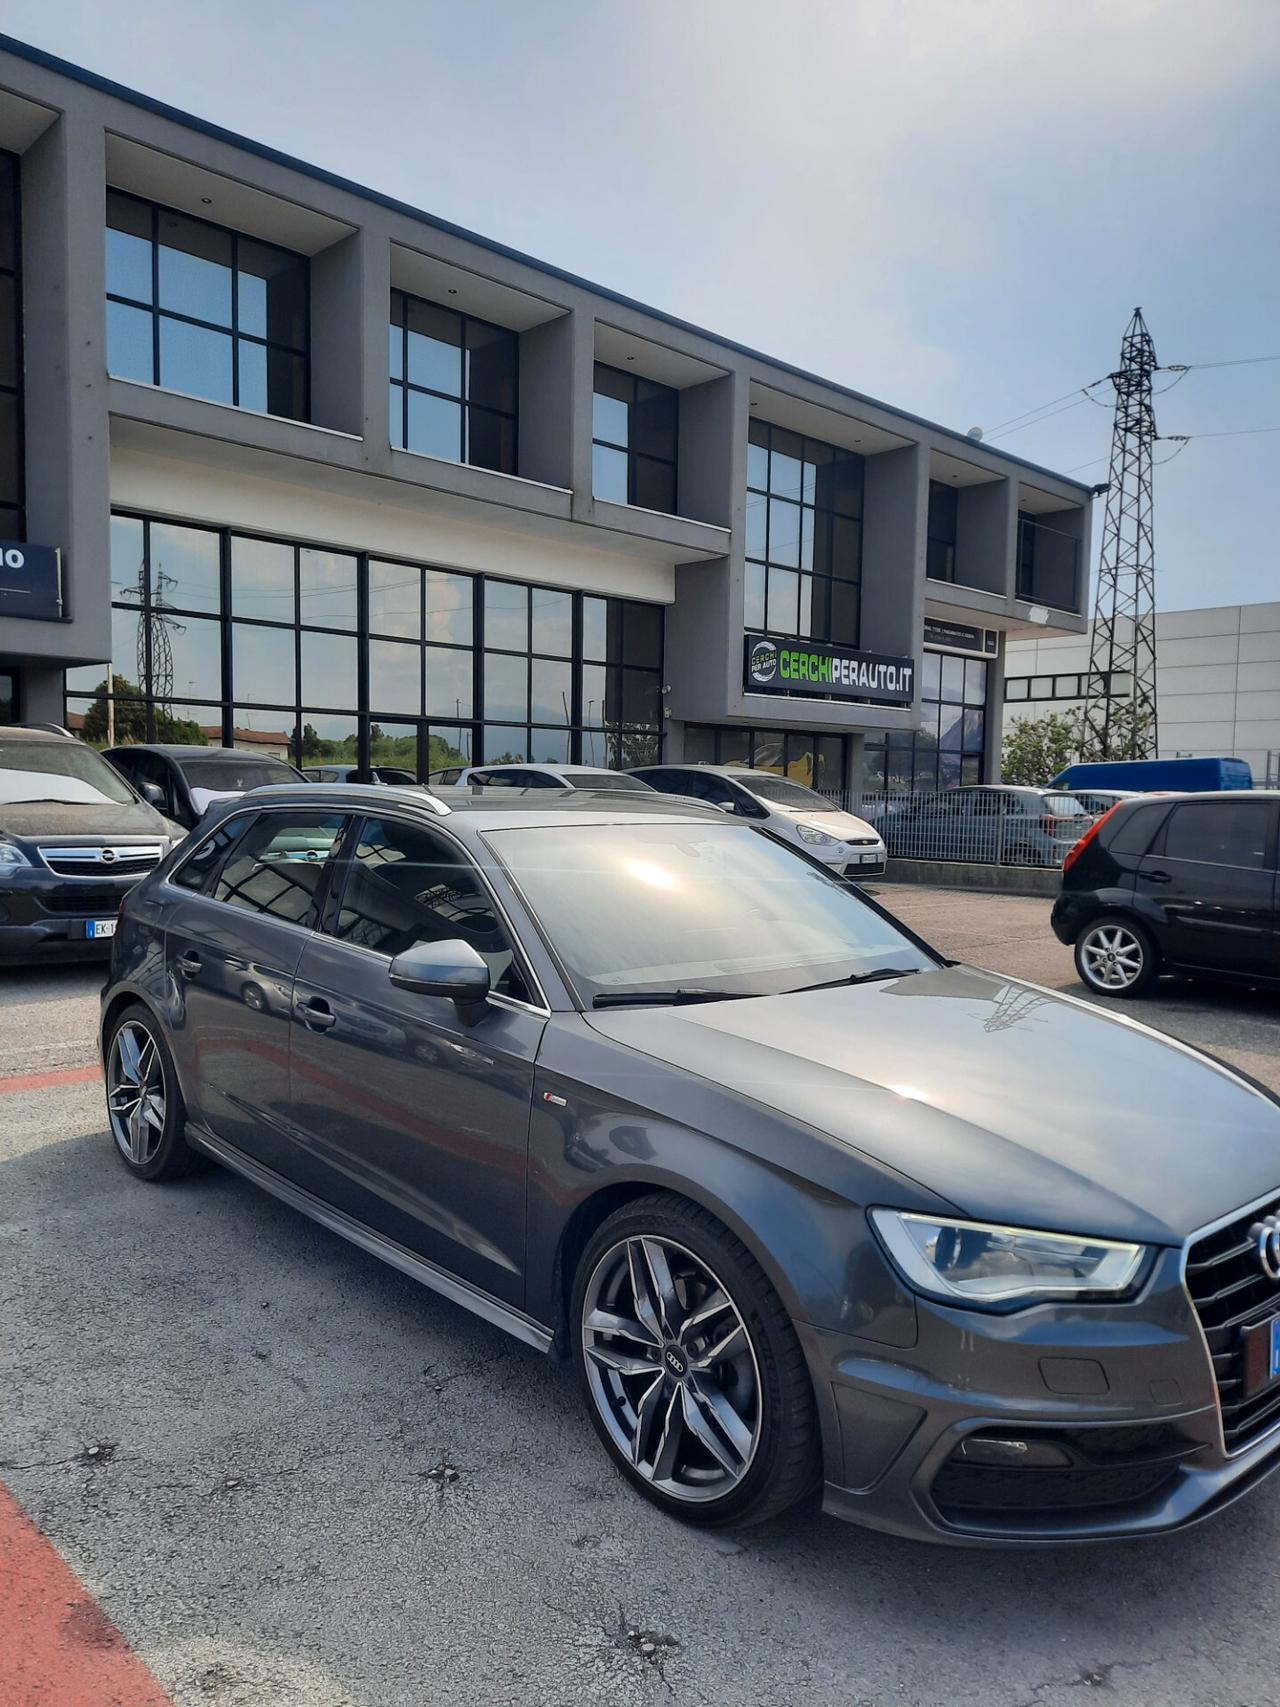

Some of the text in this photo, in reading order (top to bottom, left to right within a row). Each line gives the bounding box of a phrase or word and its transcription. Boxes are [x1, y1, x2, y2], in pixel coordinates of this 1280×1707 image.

[751, 650, 777, 665] CERCHI
[751, 658, 777, 673] PER AUTO
[780, 650, 912, 692] CERCHIPERAUTO.IT
